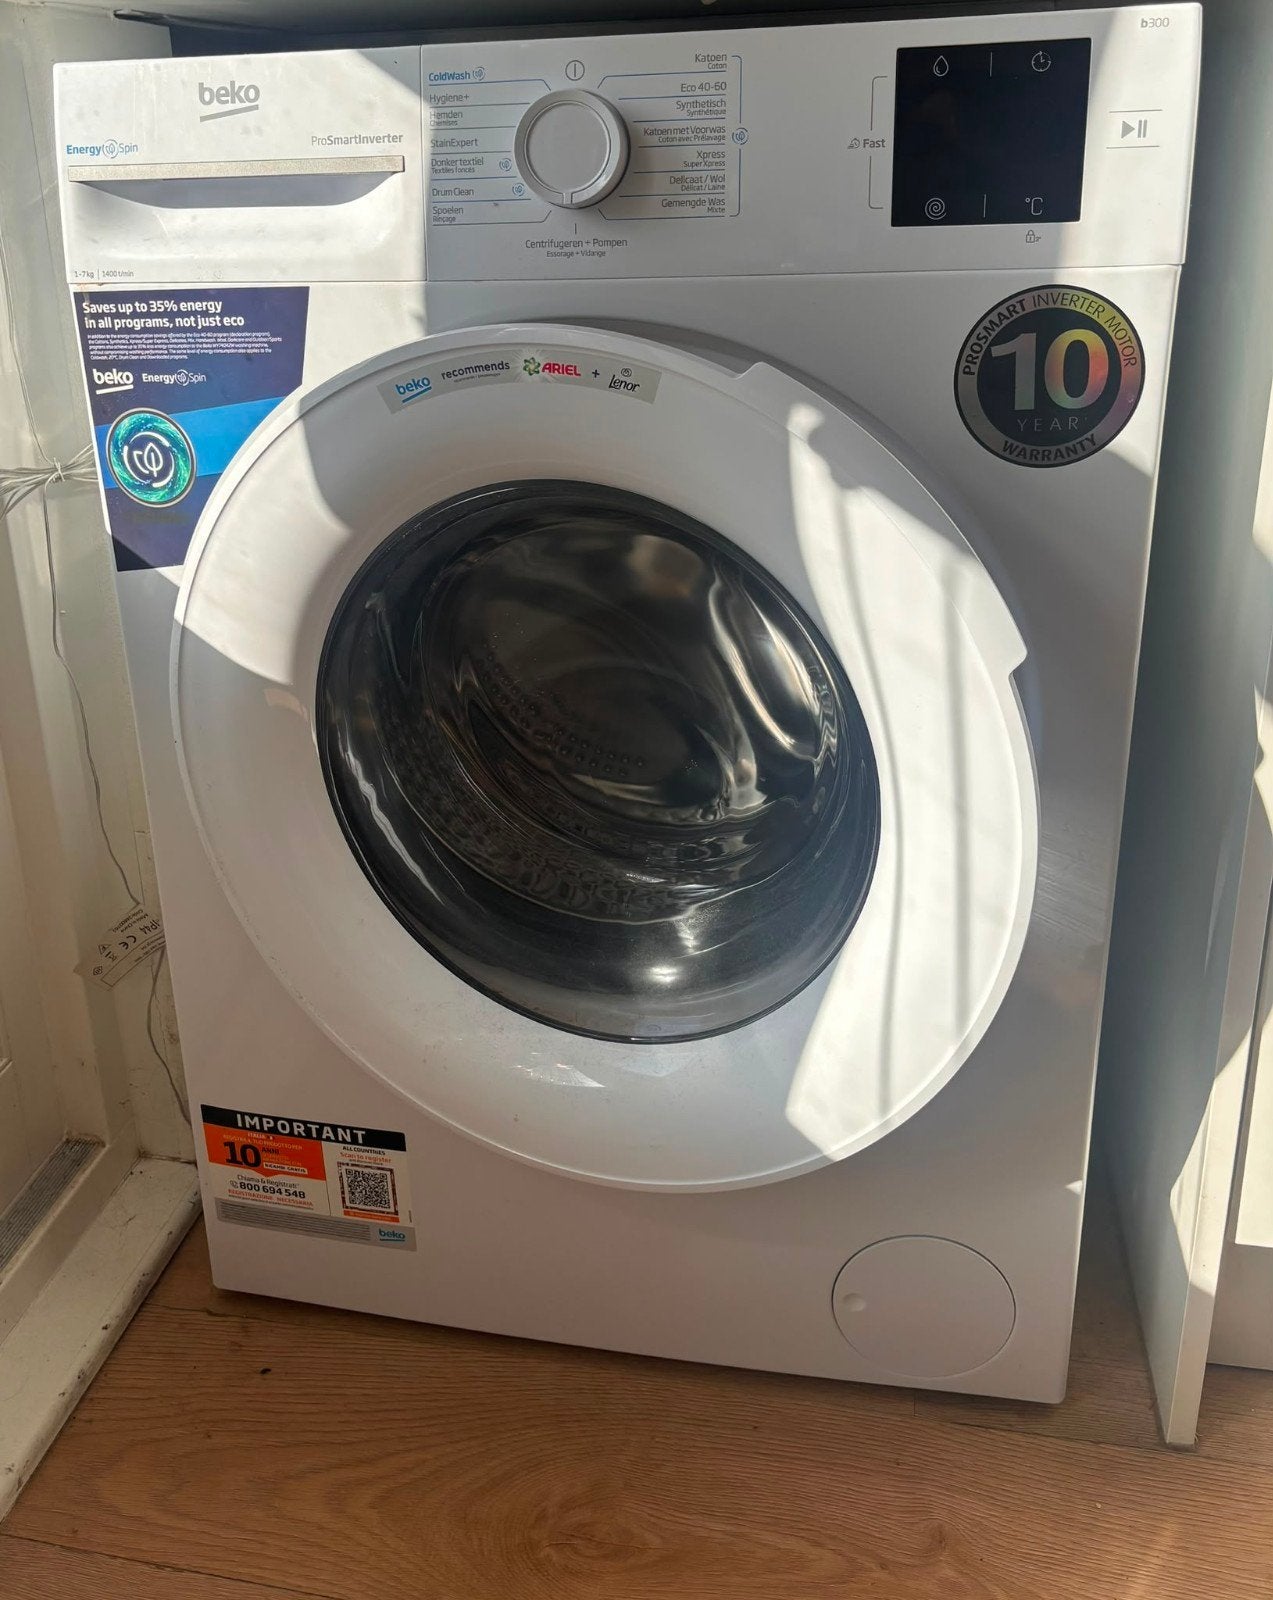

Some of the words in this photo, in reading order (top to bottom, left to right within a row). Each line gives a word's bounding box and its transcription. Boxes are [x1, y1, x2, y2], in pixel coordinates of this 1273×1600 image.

[1140, 17, 1170, 29] b300
[694, 53, 727, 62] Katoen
[707, 62, 727, 70] Coton
[428, 70, 470, 81] ColdWash
[199, 80, 260, 106] beko
[680, 84, 697, 93] Eco
[698, 82, 727, 92] 40-60
[429, 94, 470, 105] Hygiene+
[676, 100, 727, 111] Synthetisch
[430, 110, 464, 120] Hemden
[643, 127, 673, 136] Katoen
[690, 124, 726, 134] Voorwas
[311, 133, 404, 146] ProSmartInverter
[430, 138, 478, 148] StainExpert
[862, 138, 886, 148] Fast
[66, 144, 102, 156] Energy
[118, 142, 138, 155] Spin
[696, 150, 726, 160] Xpress
[684, 160, 703, 169] Super
[703, 160, 726, 168] Xpress
[670, 176, 702, 185] Delicaat
[710, 174, 726, 184] Wol
[432, 188, 453, 197] Drum
[454, 187, 474, 196] Clean
[662, 199, 706, 209] Gemengde
[708, 197, 726, 206] Was
[432, 206, 464, 217] Spoelen
[706, 206, 726, 214] Mixte
[526, 238, 584, 250] Centrifugeren
[592, 238, 628, 248] Pompen
[546, 250, 574, 258] Essorage
[580, 249, 606, 258] Vidange
[82, 302, 116, 314] Saves
[118, 304, 132, 315] up
[134, 302, 148, 312] to
[149, 300, 178, 312] 35%
[180, 301, 222, 313] energy
[84, 317, 96, 328] in
[98, 316, 112, 328] all
[114, 317, 174, 330] programs,
[176, 316, 196, 328] not
[197, 314, 222, 329] just
[224, 316, 245, 326] eco
[962, 298, 1026, 376] PROSMART
[1032, 292, 1106, 319] INVERTER
[1104, 316, 1138, 368] MOTOR
[991, 329, 1109, 411] 10
[92, 368, 134, 385] beko
[142, 372, 175, 384] Energy
[189, 372, 206, 384] Spin
[395, 377, 431, 395] beko
[441, 360, 510, 380] recommends
[541, 362, 582, 376] ARIEL
[608, 374, 640, 392] Lenor
[1018, 416, 1079, 432] YEAR
[1002, 433, 1098, 462] WARRANTY
[236, 1113, 366, 1144] IMPORTANT
[223, 1141, 262, 1168] 10
[239, 1181, 260, 1192] 800
[262, 1185, 283, 1196] 694
[284, 1188, 306, 1199] 548
[378, 1228, 406, 1240] beko
